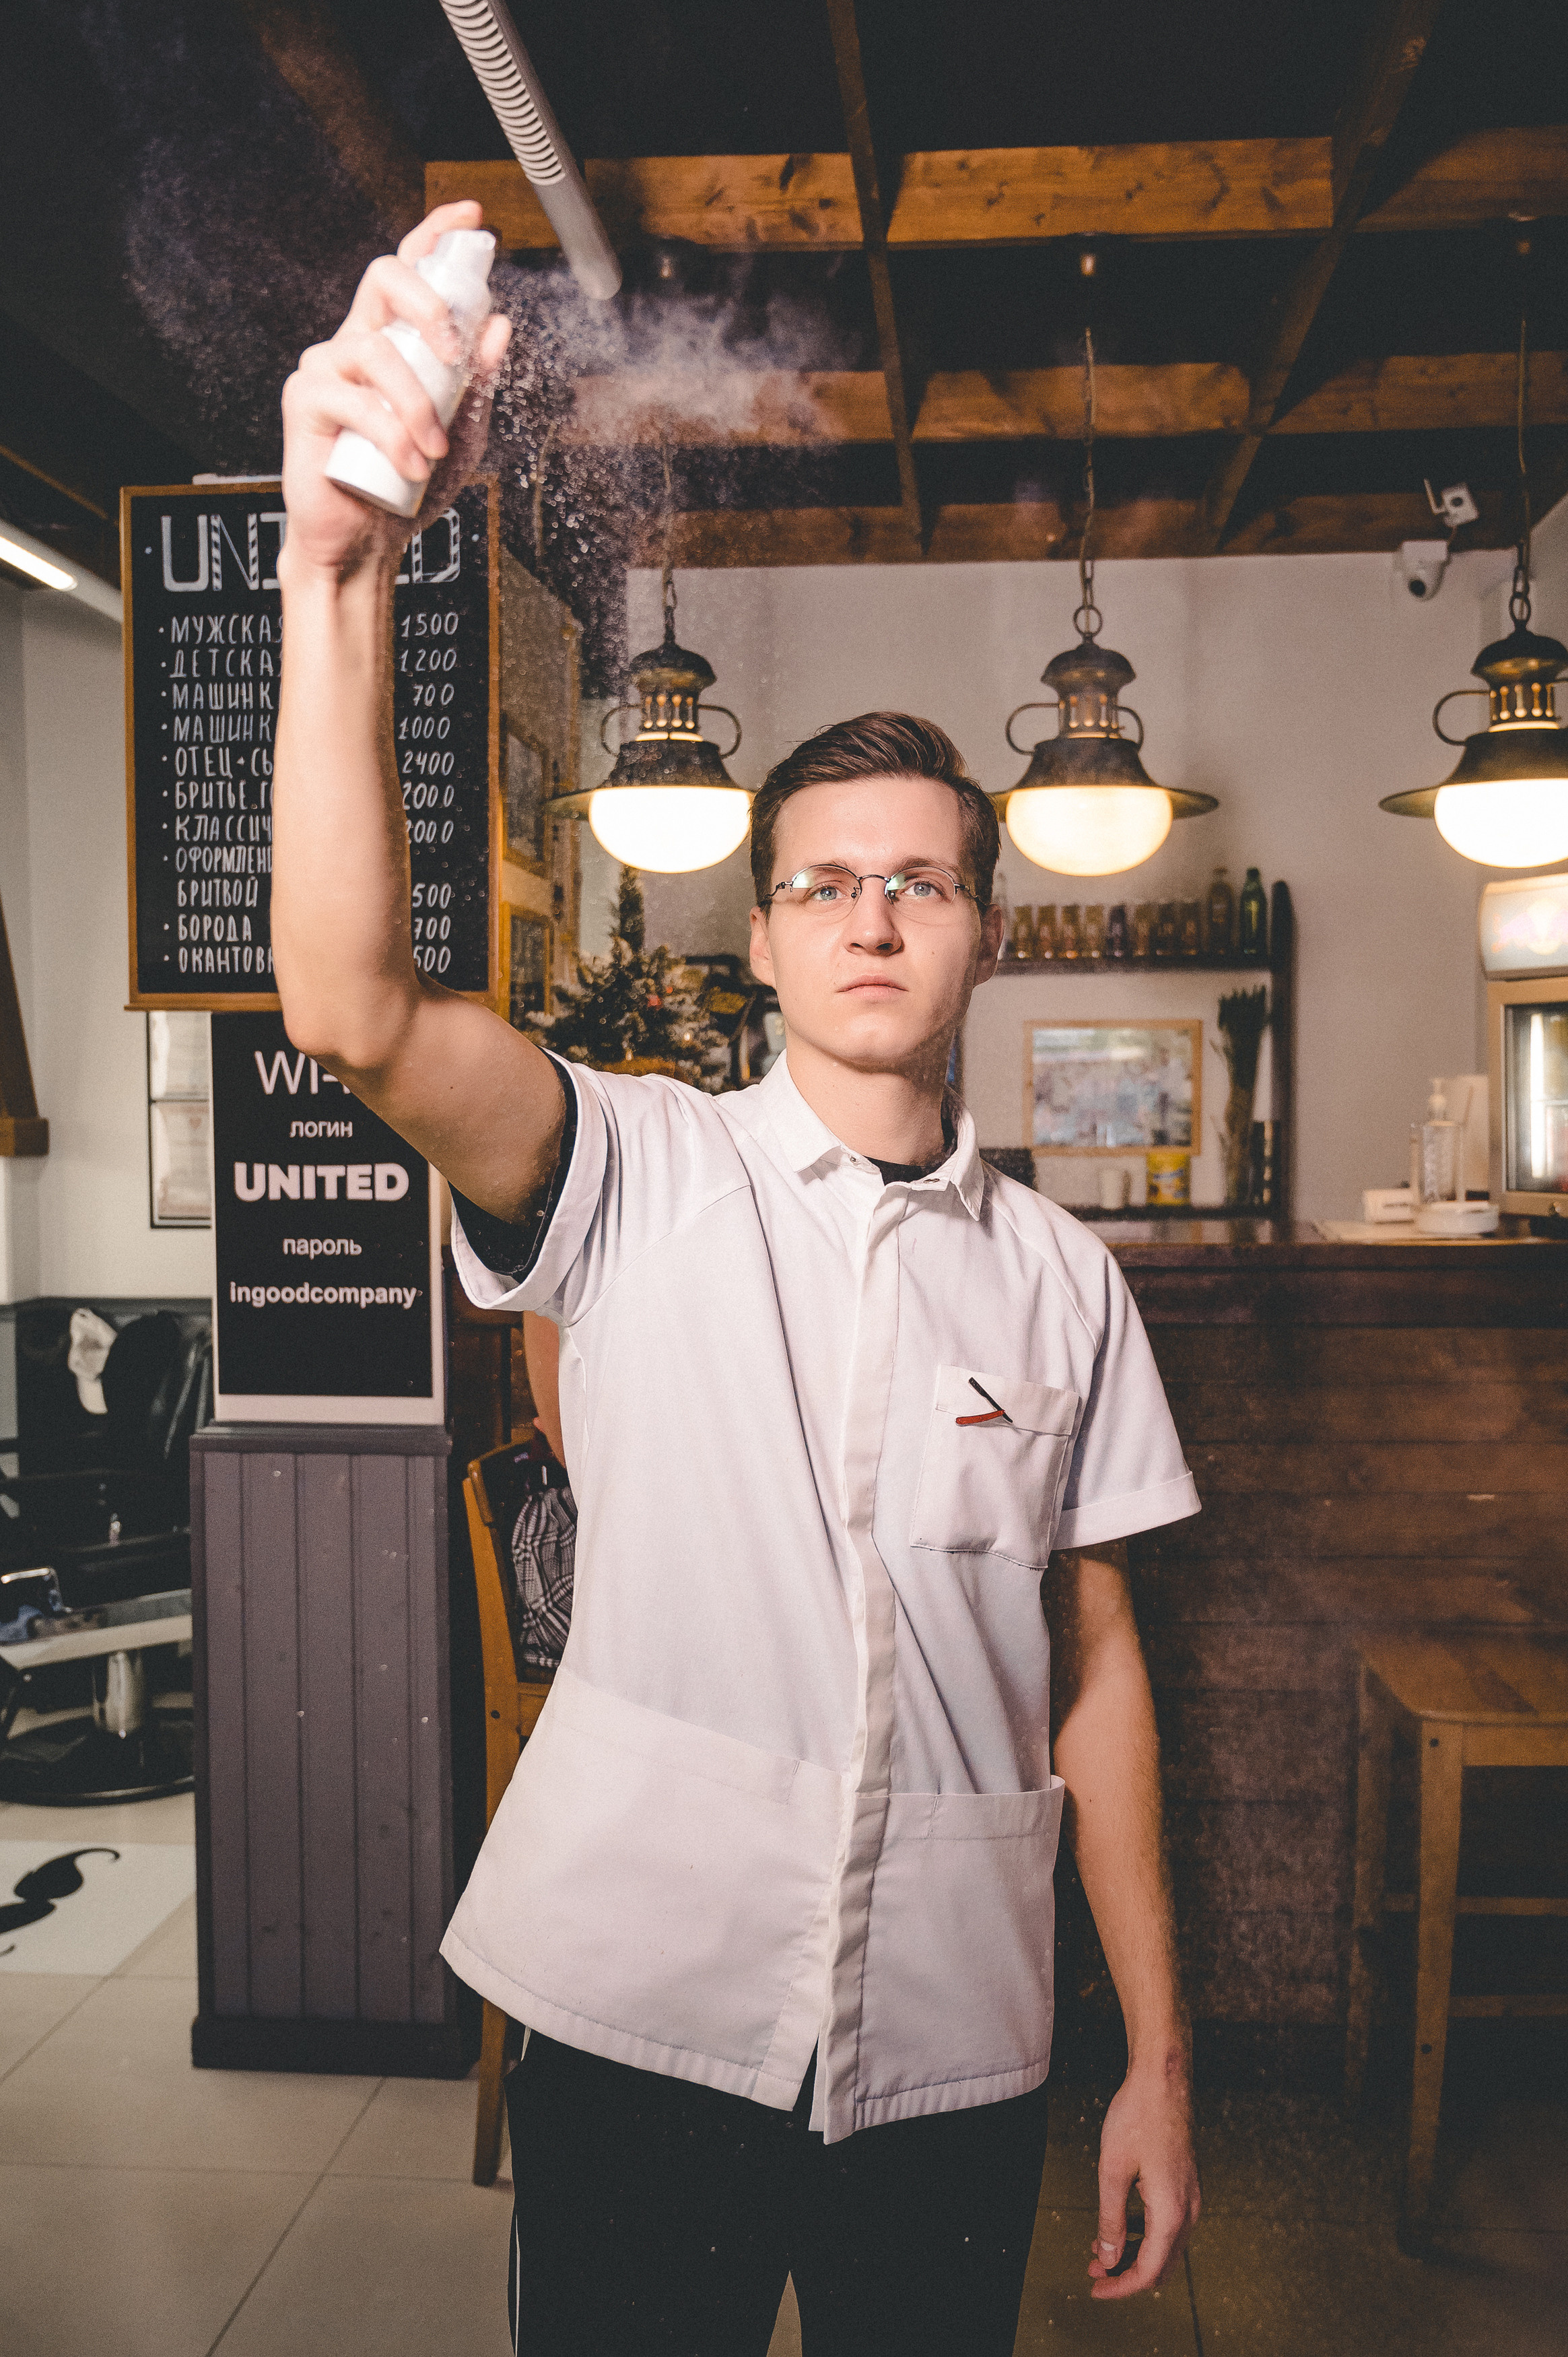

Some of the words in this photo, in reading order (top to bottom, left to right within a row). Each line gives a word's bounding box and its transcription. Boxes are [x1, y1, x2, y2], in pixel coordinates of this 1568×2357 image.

[401, 611, 459, 638] 1500
[170, 648, 281, 677] ДЕТСКА
[400, 648, 457, 672] 1200
[172, 682, 274, 710] МАШИНК
[413, 683, 454, 706] 700
[174, 714, 272, 743] МАШИНК
[398, 715, 450, 740] 1000
[175, 745, 233, 778] ОТЕЦ
[402, 750, 454, 776] 2400
[175, 780, 248, 809] БРИТЬЕ
[403, 781, 454, 810] 2000
[175, 814, 273, 842] КЛАССИЧ
[177, 875, 259, 908] БРИТВОЙ
[411, 883, 452, 909] 500
[178, 914, 252, 942] БОРОДА
[413, 915, 451, 941] 700
[413, 945, 451, 973] 500
[254, 1050, 351, 1095] WI-
[289, 1121, 353, 1138] логин
[234, 1162, 409, 1202] UNITED
[283, 1238, 362, 1260] пароль
[230, 1281, 417, 1310] ingoodcompany
